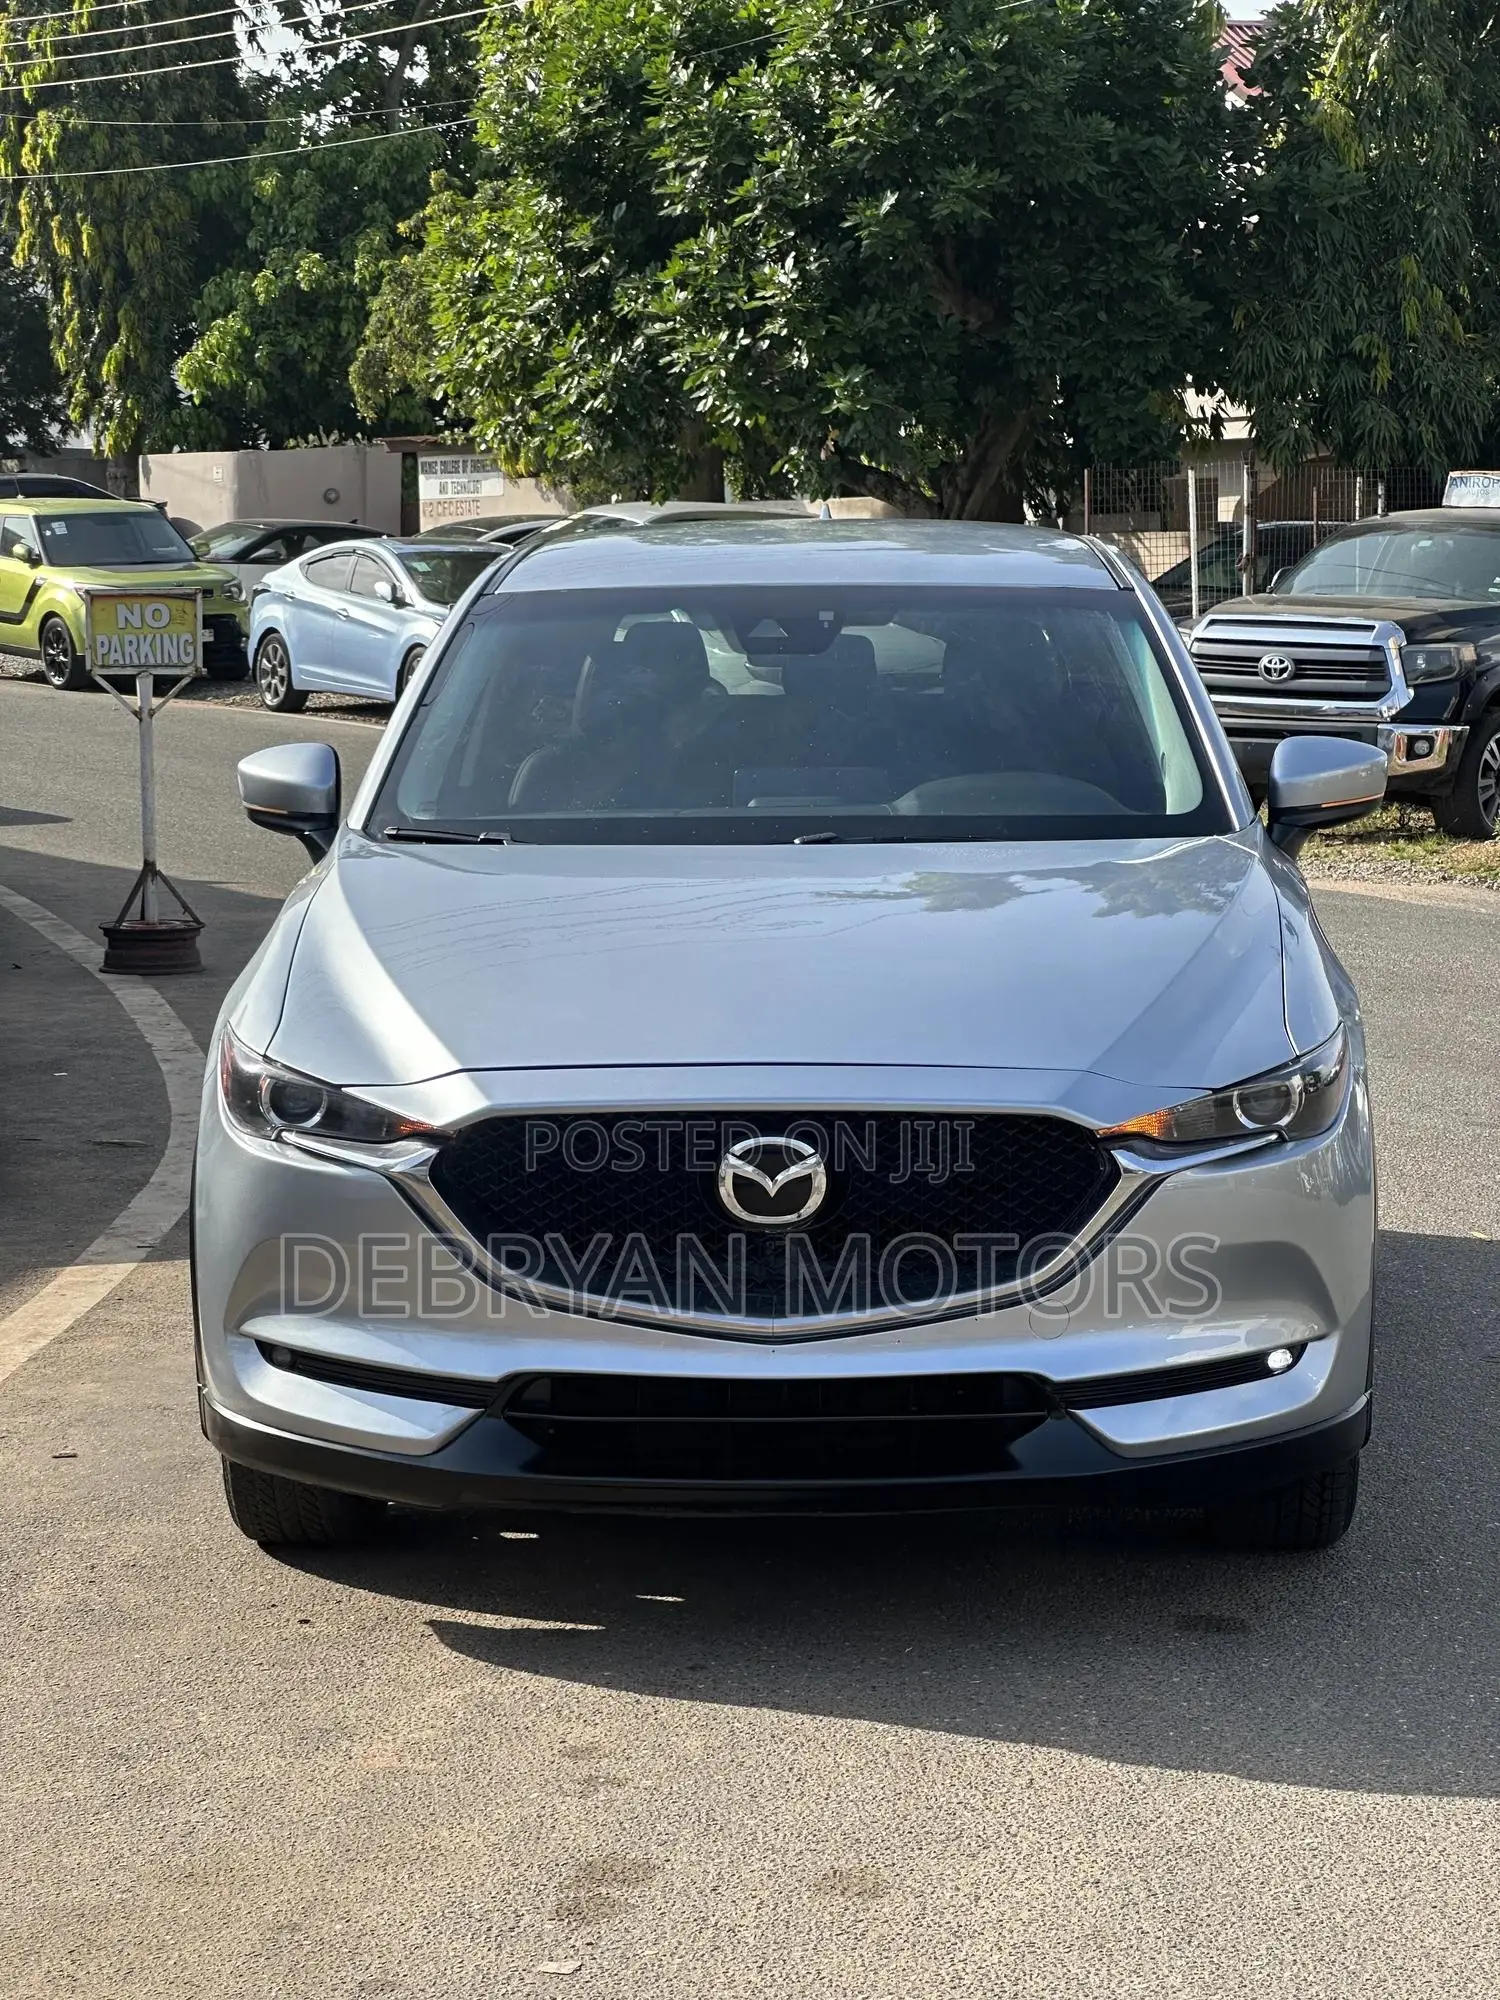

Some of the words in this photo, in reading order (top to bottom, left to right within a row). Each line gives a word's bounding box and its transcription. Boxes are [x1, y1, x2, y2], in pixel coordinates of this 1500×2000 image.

[440, 460, 460, 474] COLLEGE
[462, 460, 468, 473] OF
[439, 481, 448, 495] AND
[451, 480, 482, 494] TECHNOLOGY
[456, 500, 480, 516] ESTATE
[117, 603, 170, 629] NO
[96, 632, 194, 665] PARKING
